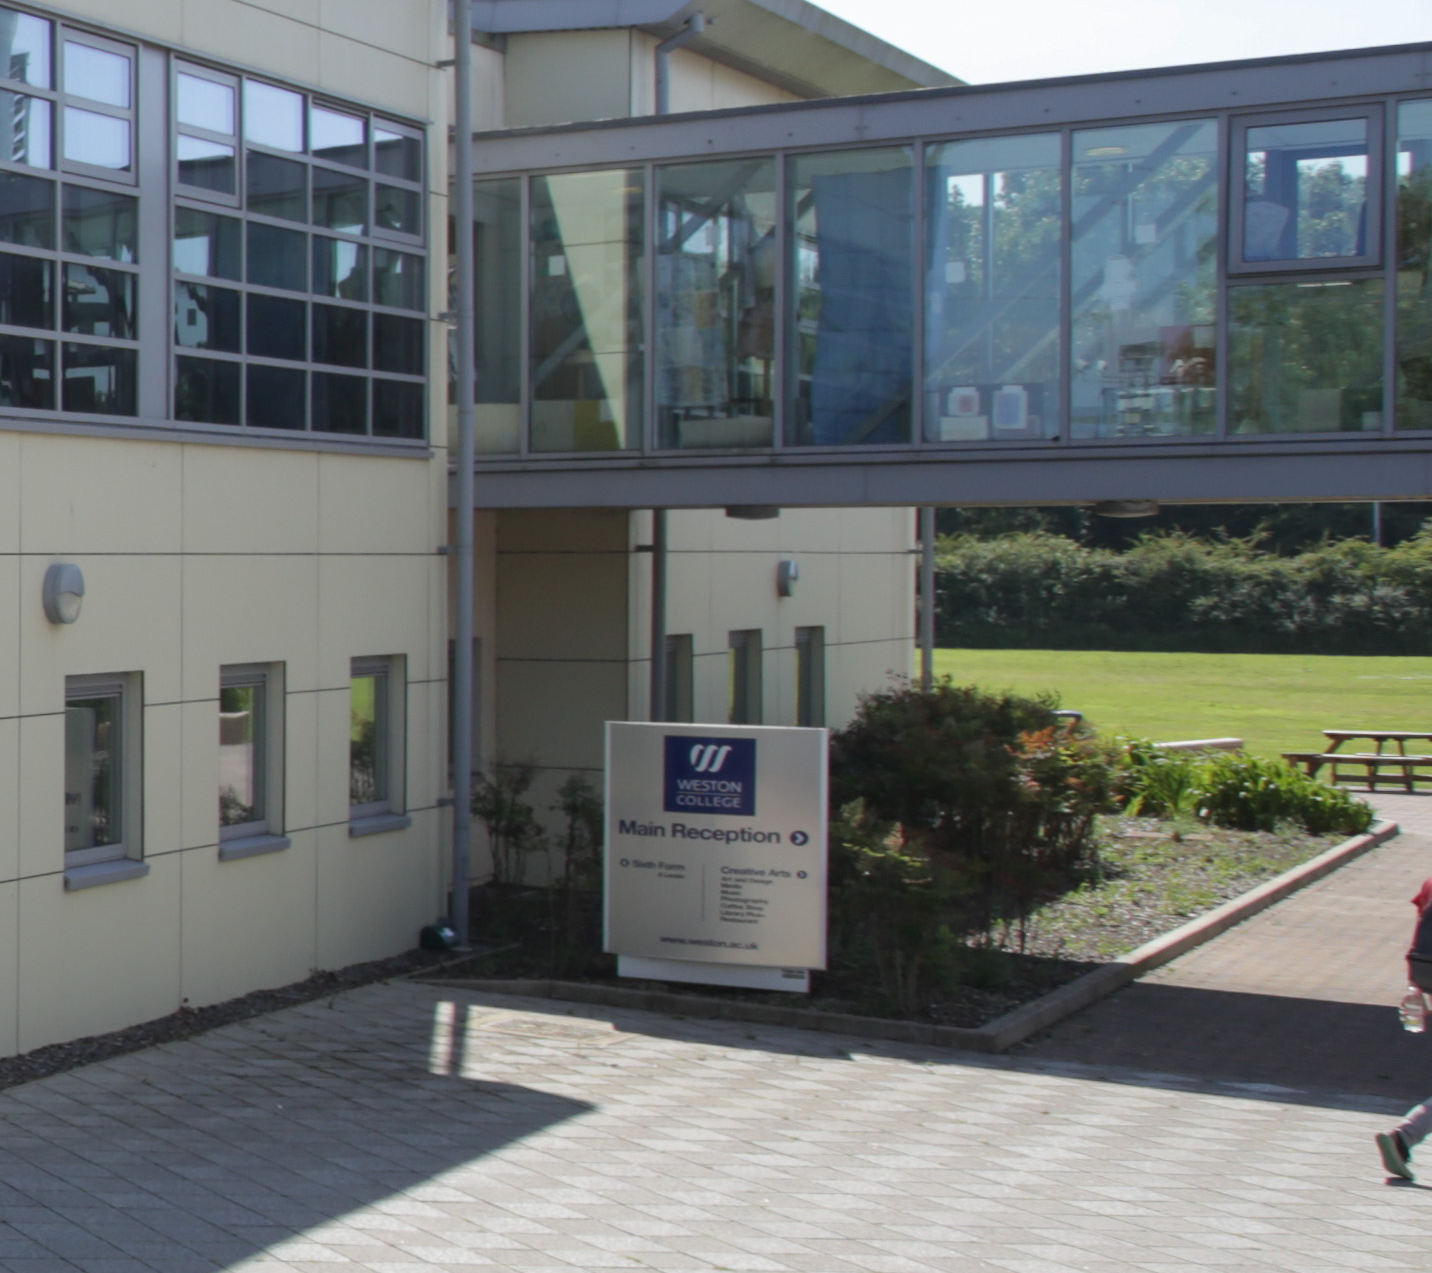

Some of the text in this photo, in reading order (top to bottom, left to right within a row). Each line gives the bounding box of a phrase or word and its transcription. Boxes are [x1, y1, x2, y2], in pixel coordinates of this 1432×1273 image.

[676, 779, 743, 793] WESTON
[675, 794, 742, 808] COLLEGE
[618, 819, 781, 845] Main Reception
[658, 861, 686, 871] Form
[720, 865, 792, 878] Creative Arts
[659, 936, 759, 950] www.weston.ac.uk
